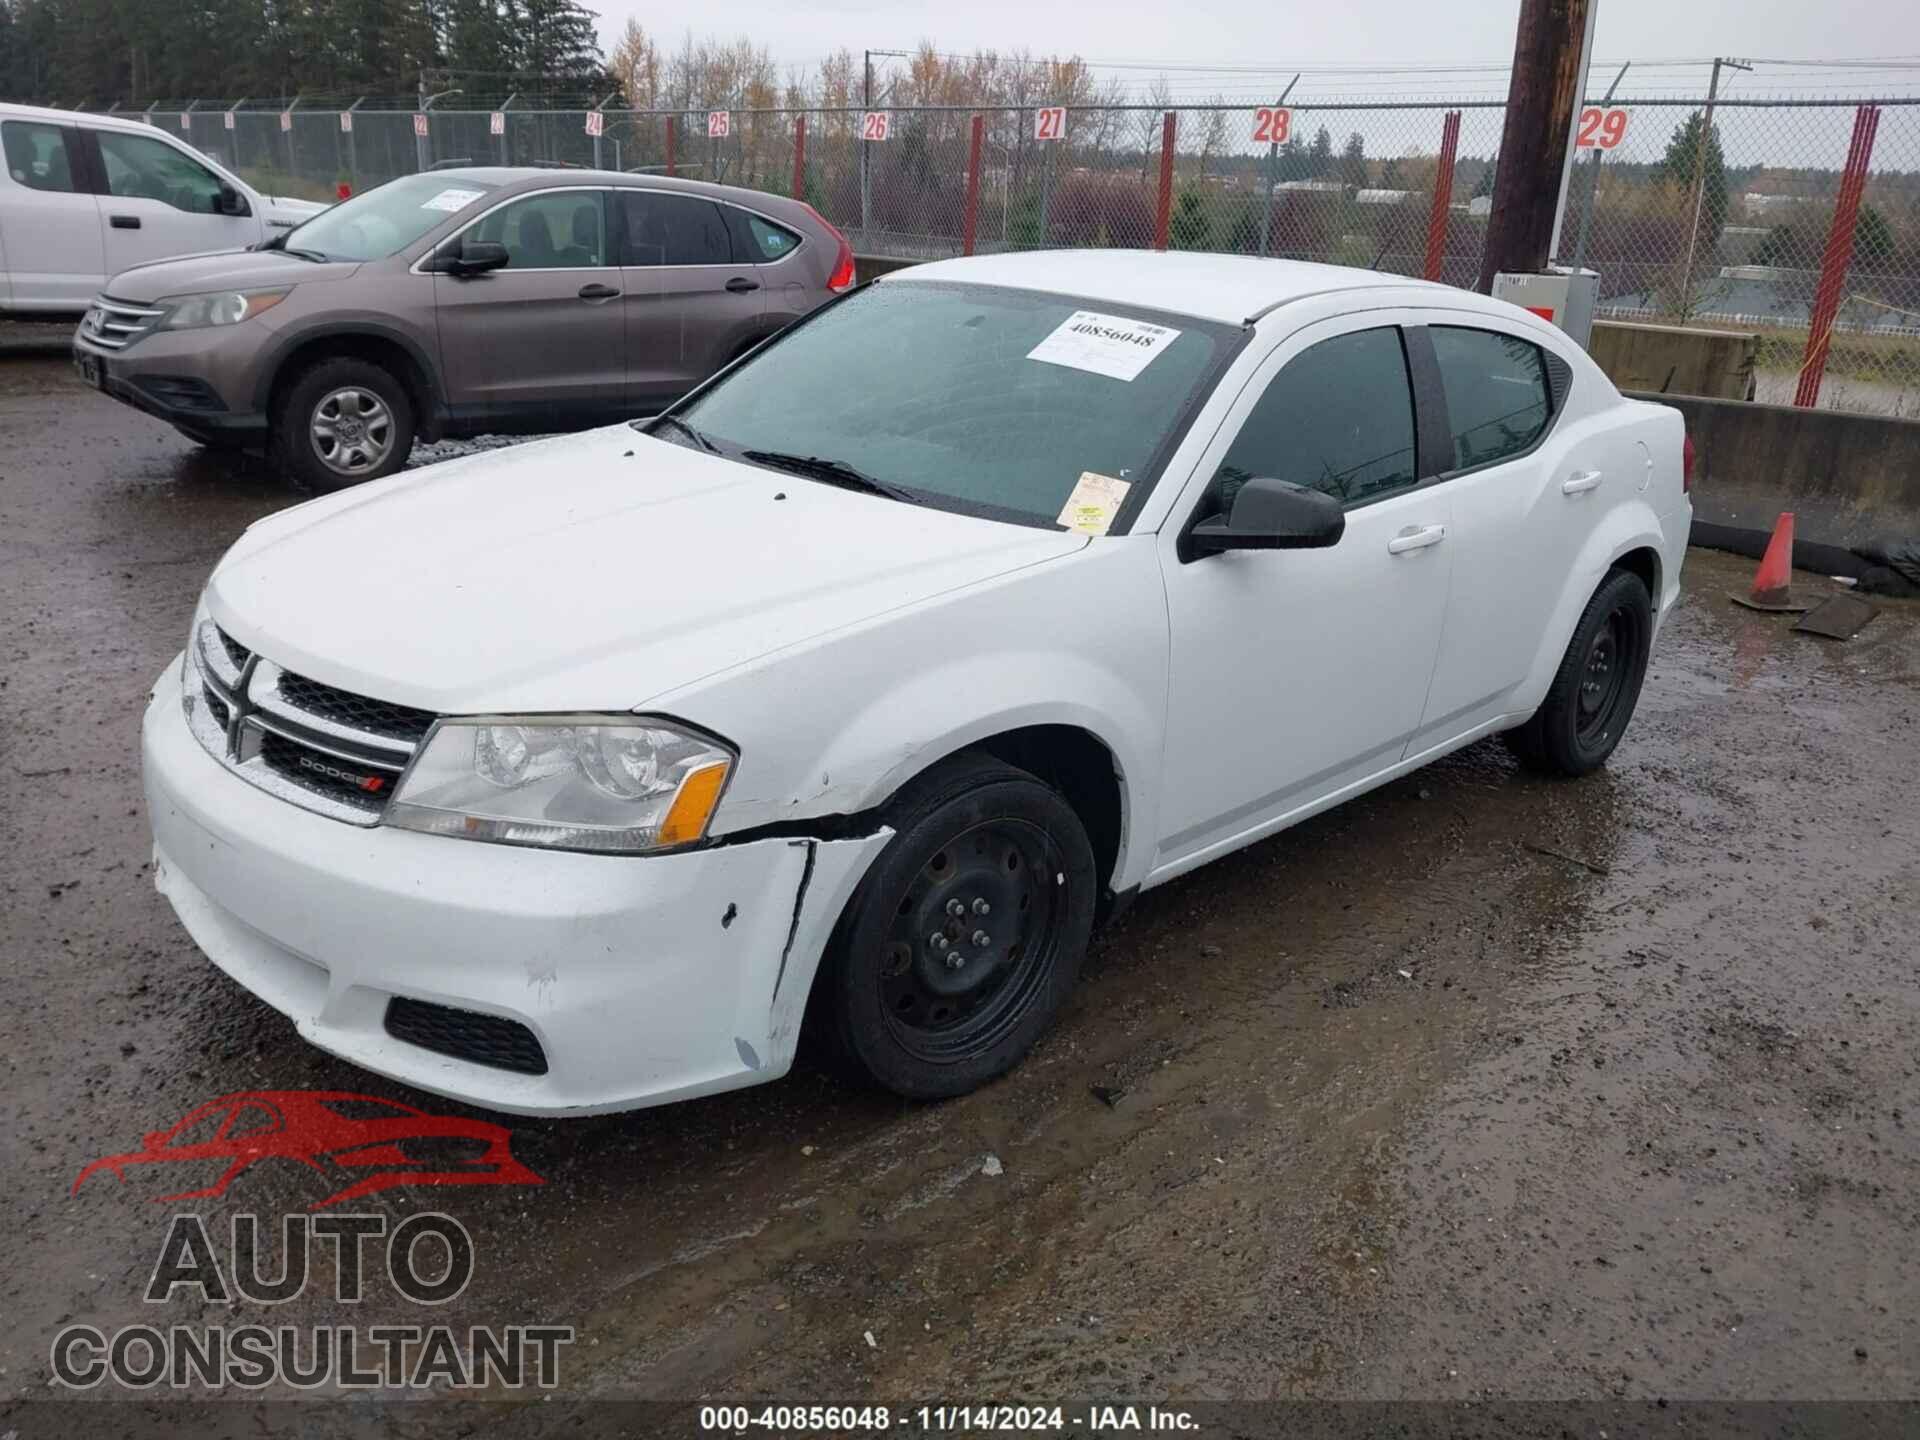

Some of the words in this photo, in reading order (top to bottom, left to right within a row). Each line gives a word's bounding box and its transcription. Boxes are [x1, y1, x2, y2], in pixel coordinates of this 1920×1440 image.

[587, 113, 601, 134] 24
[710, 112, 728, 136] 25
[864, 114, 887, 139] 26
[1039, 109, 1062, 138] 27
[1254, 109, 1290, 142] 28
[1577, 108, 1628, 149] 29
[1070, 322, 1156, 348] 40856048
[300, 756, 370, 786] DODGE
